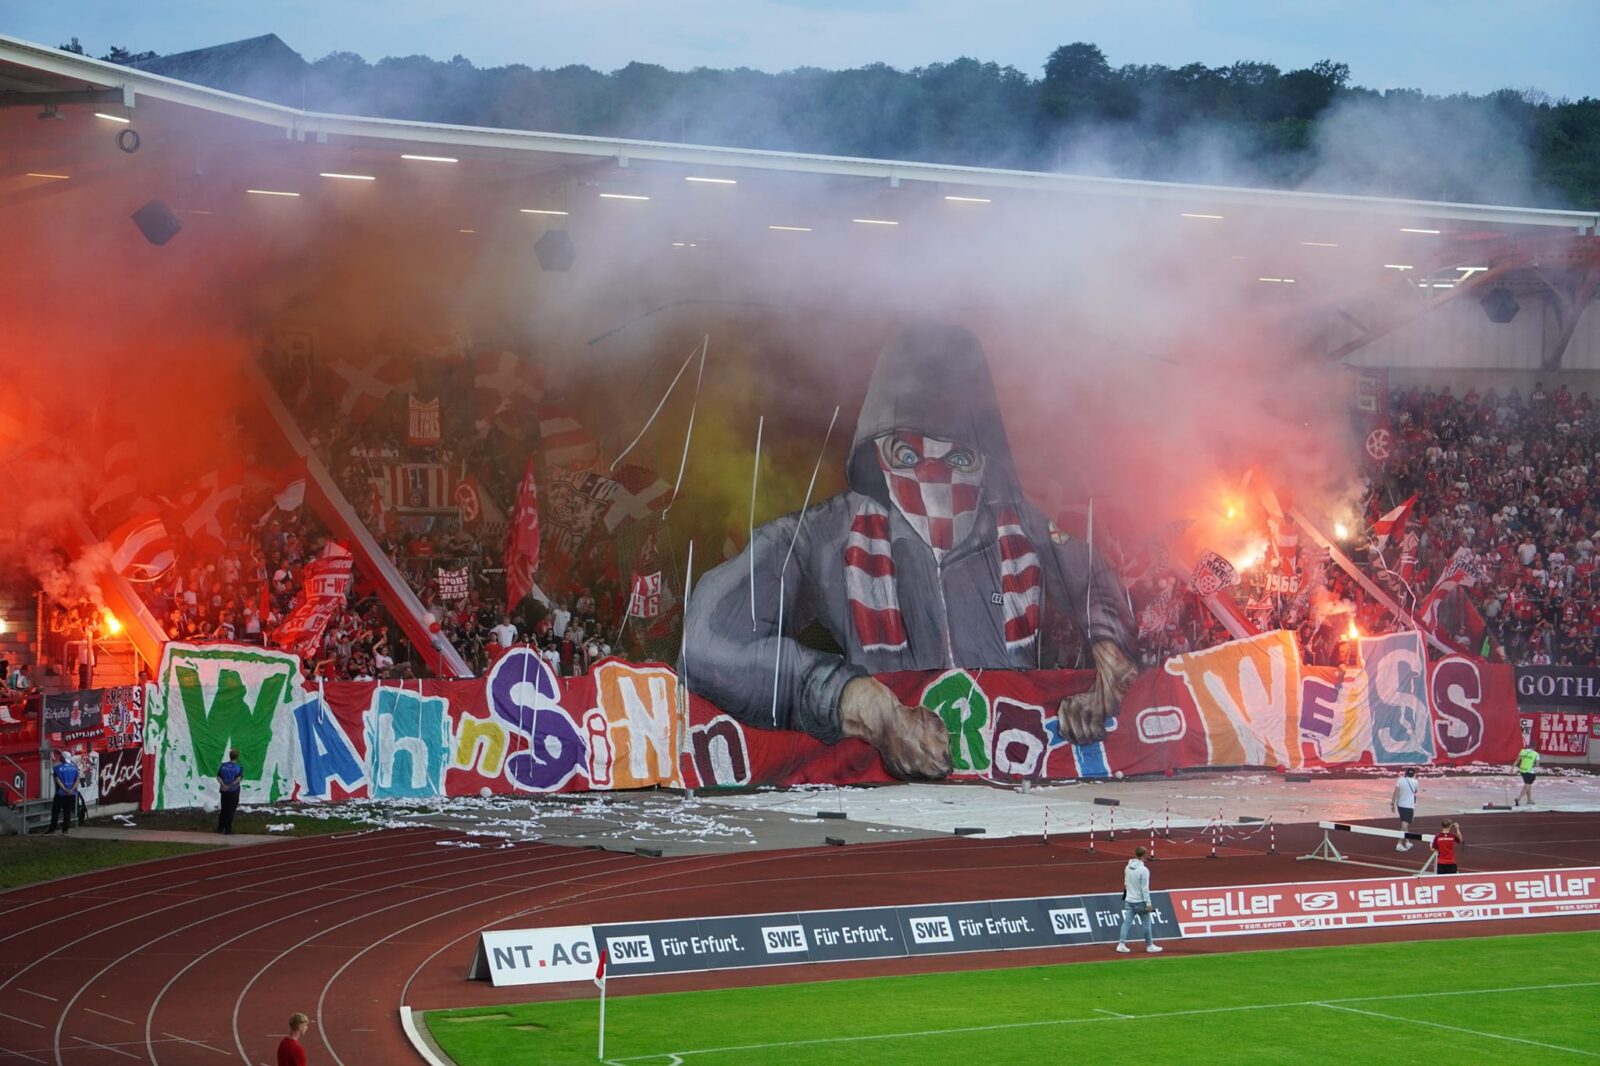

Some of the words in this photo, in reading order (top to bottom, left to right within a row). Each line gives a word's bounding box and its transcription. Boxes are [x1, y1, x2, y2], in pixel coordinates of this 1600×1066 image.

[1266, 574, 1298, 593] 1966
[1518, 675, 1600, 697] GOTH
[1540, 713, 1588, 732] ELTE
[1540, 732, 1568, 752] TAL
[914, 921, 949, 940] SWE
[958, 918, 983, 936] Für
[985, 916, 1035, 935] Erfurt.
[1055, 912, 1087, 931] SWE
[1095, 909, 1120, 927] Für
[612, 940, 649, 960] SWE
[660, 936, 689, 957] Für
[690, 933, 745, 954] Erfurt.
[767, 929, 803, 948] SWE
[813, 926, 840, 946] Für
[841, 924, 894, 943] Erfurt.
